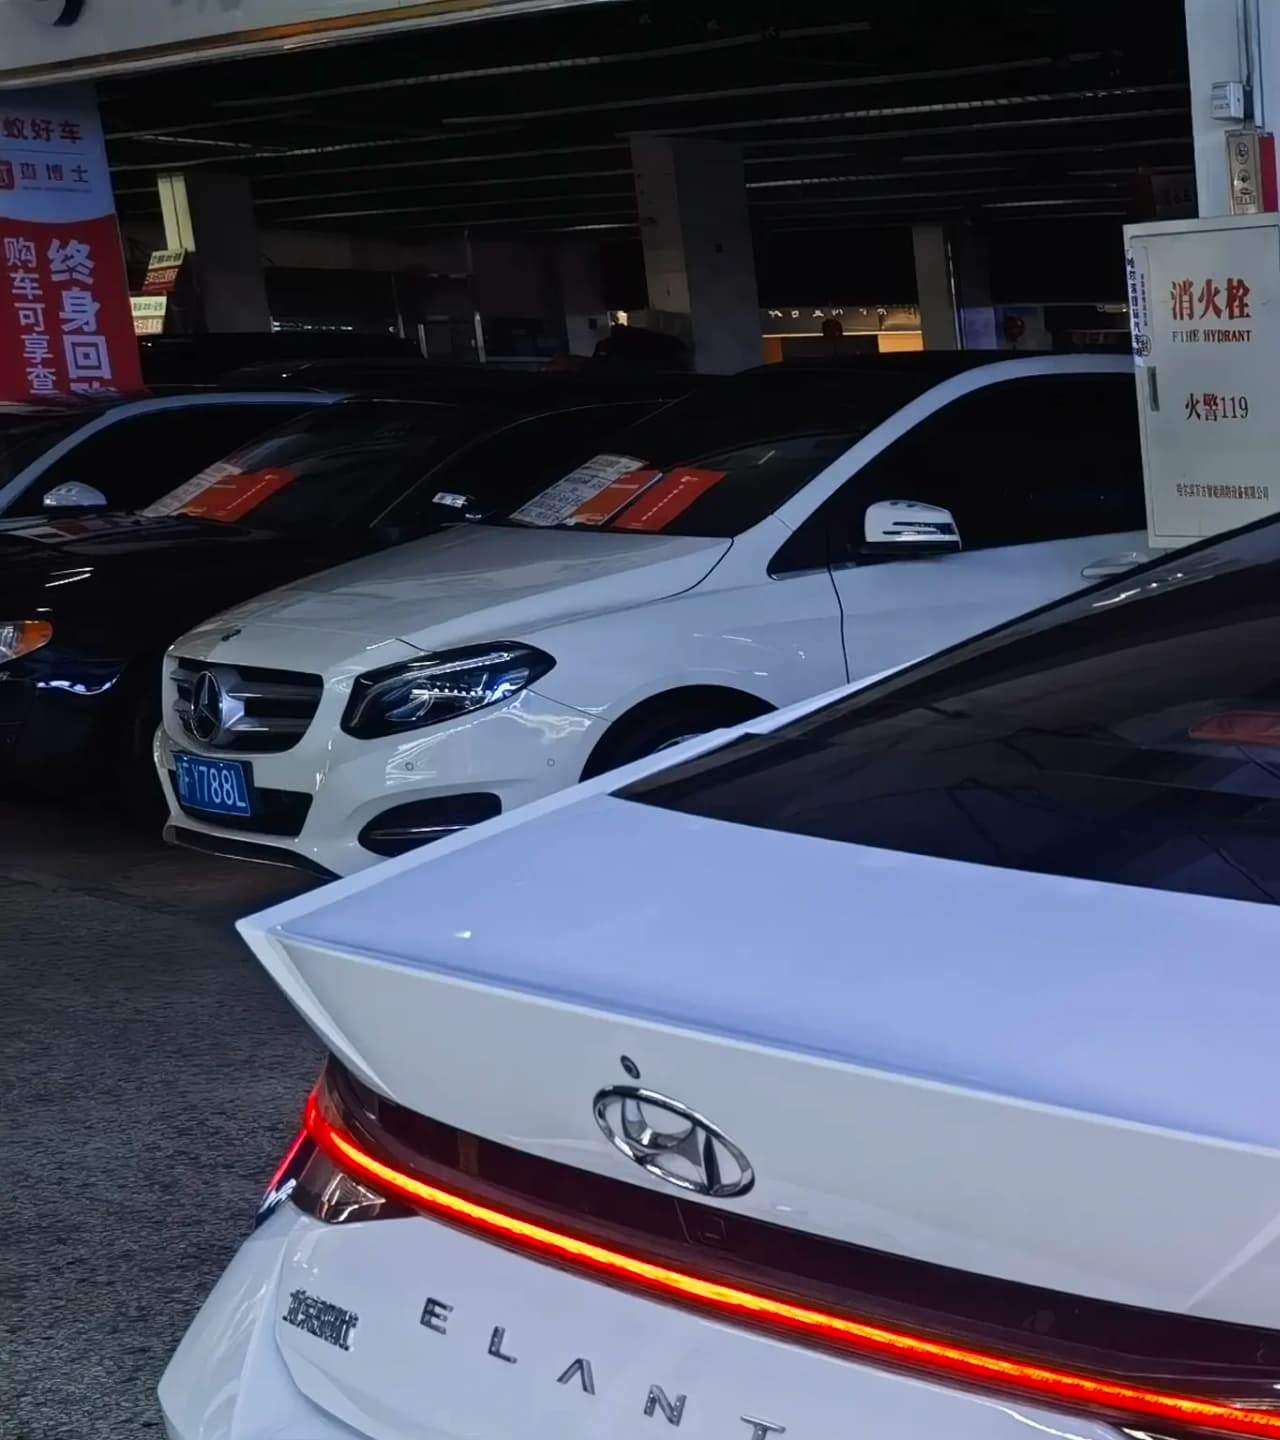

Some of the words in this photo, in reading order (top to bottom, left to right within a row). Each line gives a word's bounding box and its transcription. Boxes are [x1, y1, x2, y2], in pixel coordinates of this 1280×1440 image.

[47, 238, 120, 395] 终身回
[1170, 277, 1251, 321] 消火栓
[1204, 329, 1252, 343] HYDRANT
[1185, 392, 1249, 422] 火警119
